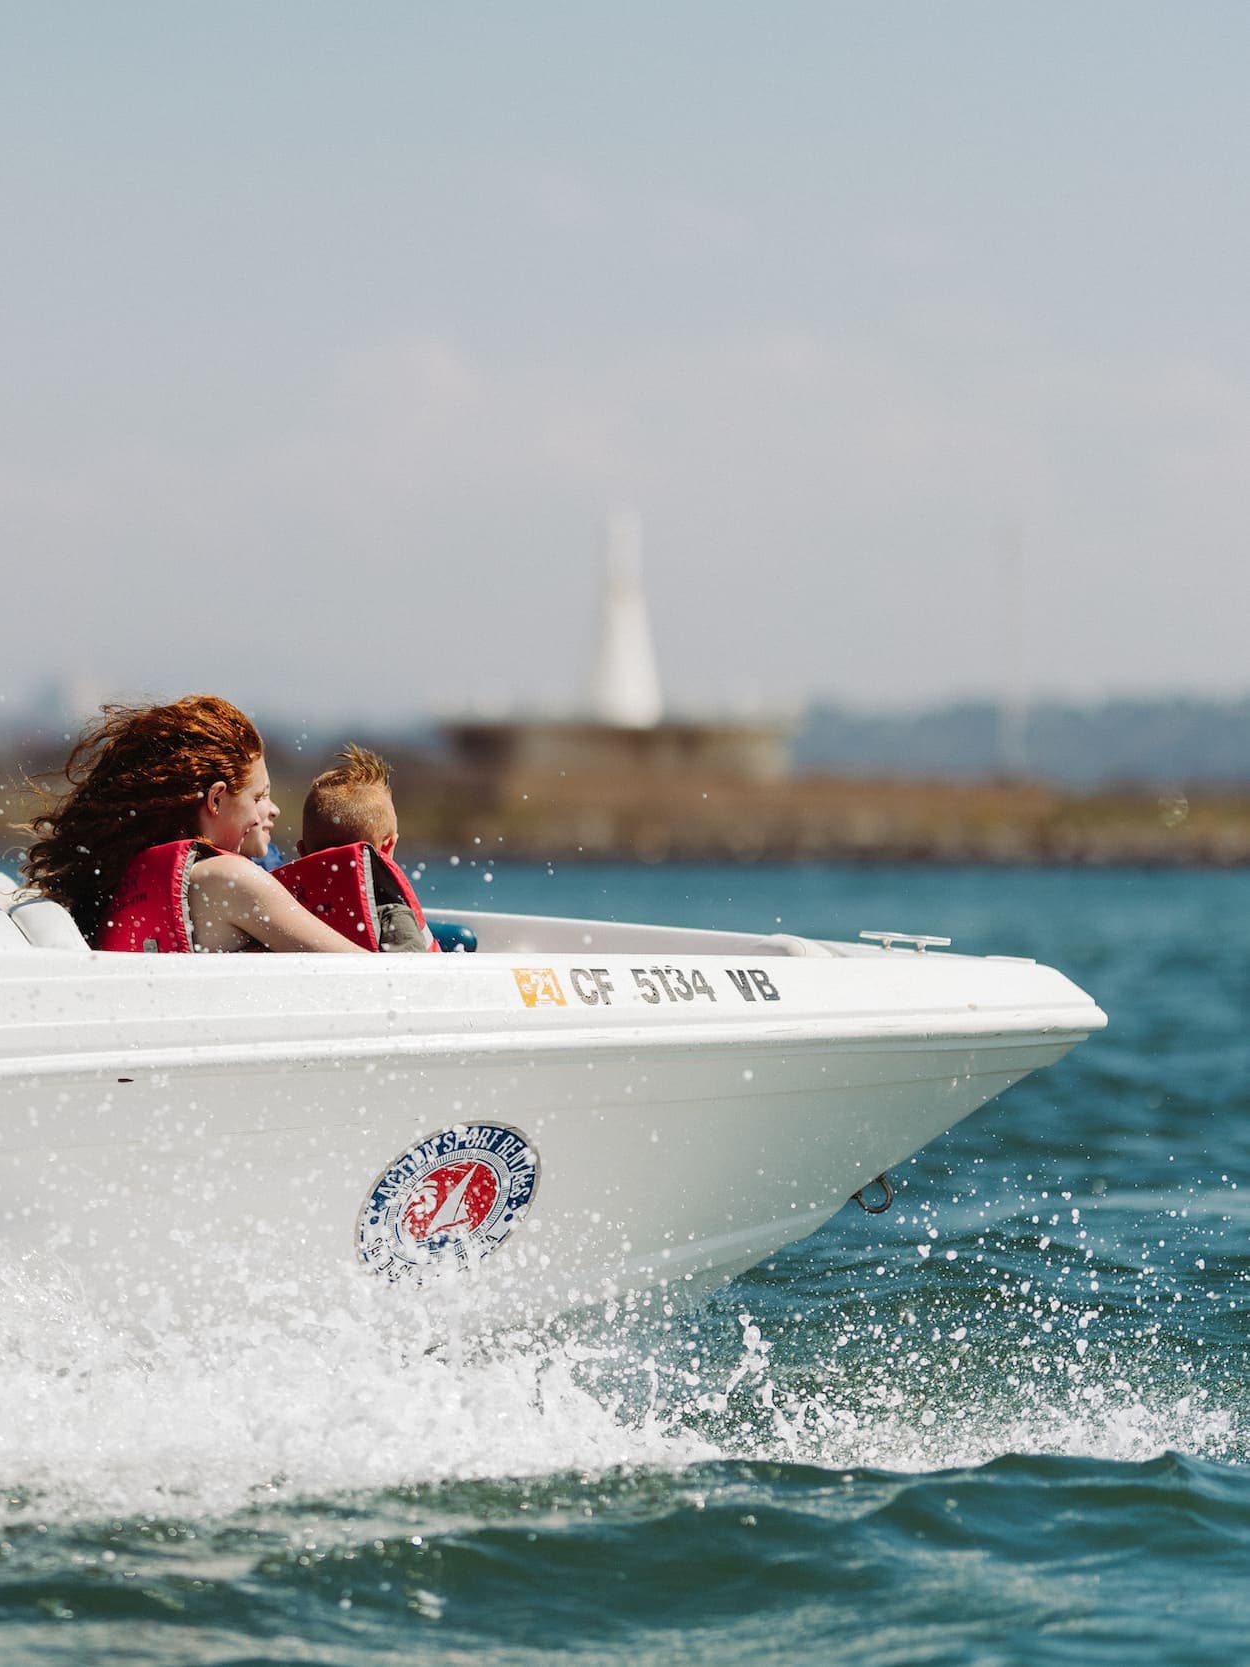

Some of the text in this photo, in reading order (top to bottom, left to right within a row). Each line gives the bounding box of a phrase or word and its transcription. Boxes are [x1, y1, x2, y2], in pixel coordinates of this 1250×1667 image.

[570, 968, 781, 1005] CF 5134 VB
[377, 1126, 536, 1199] ACTION SPORT RENTALS
